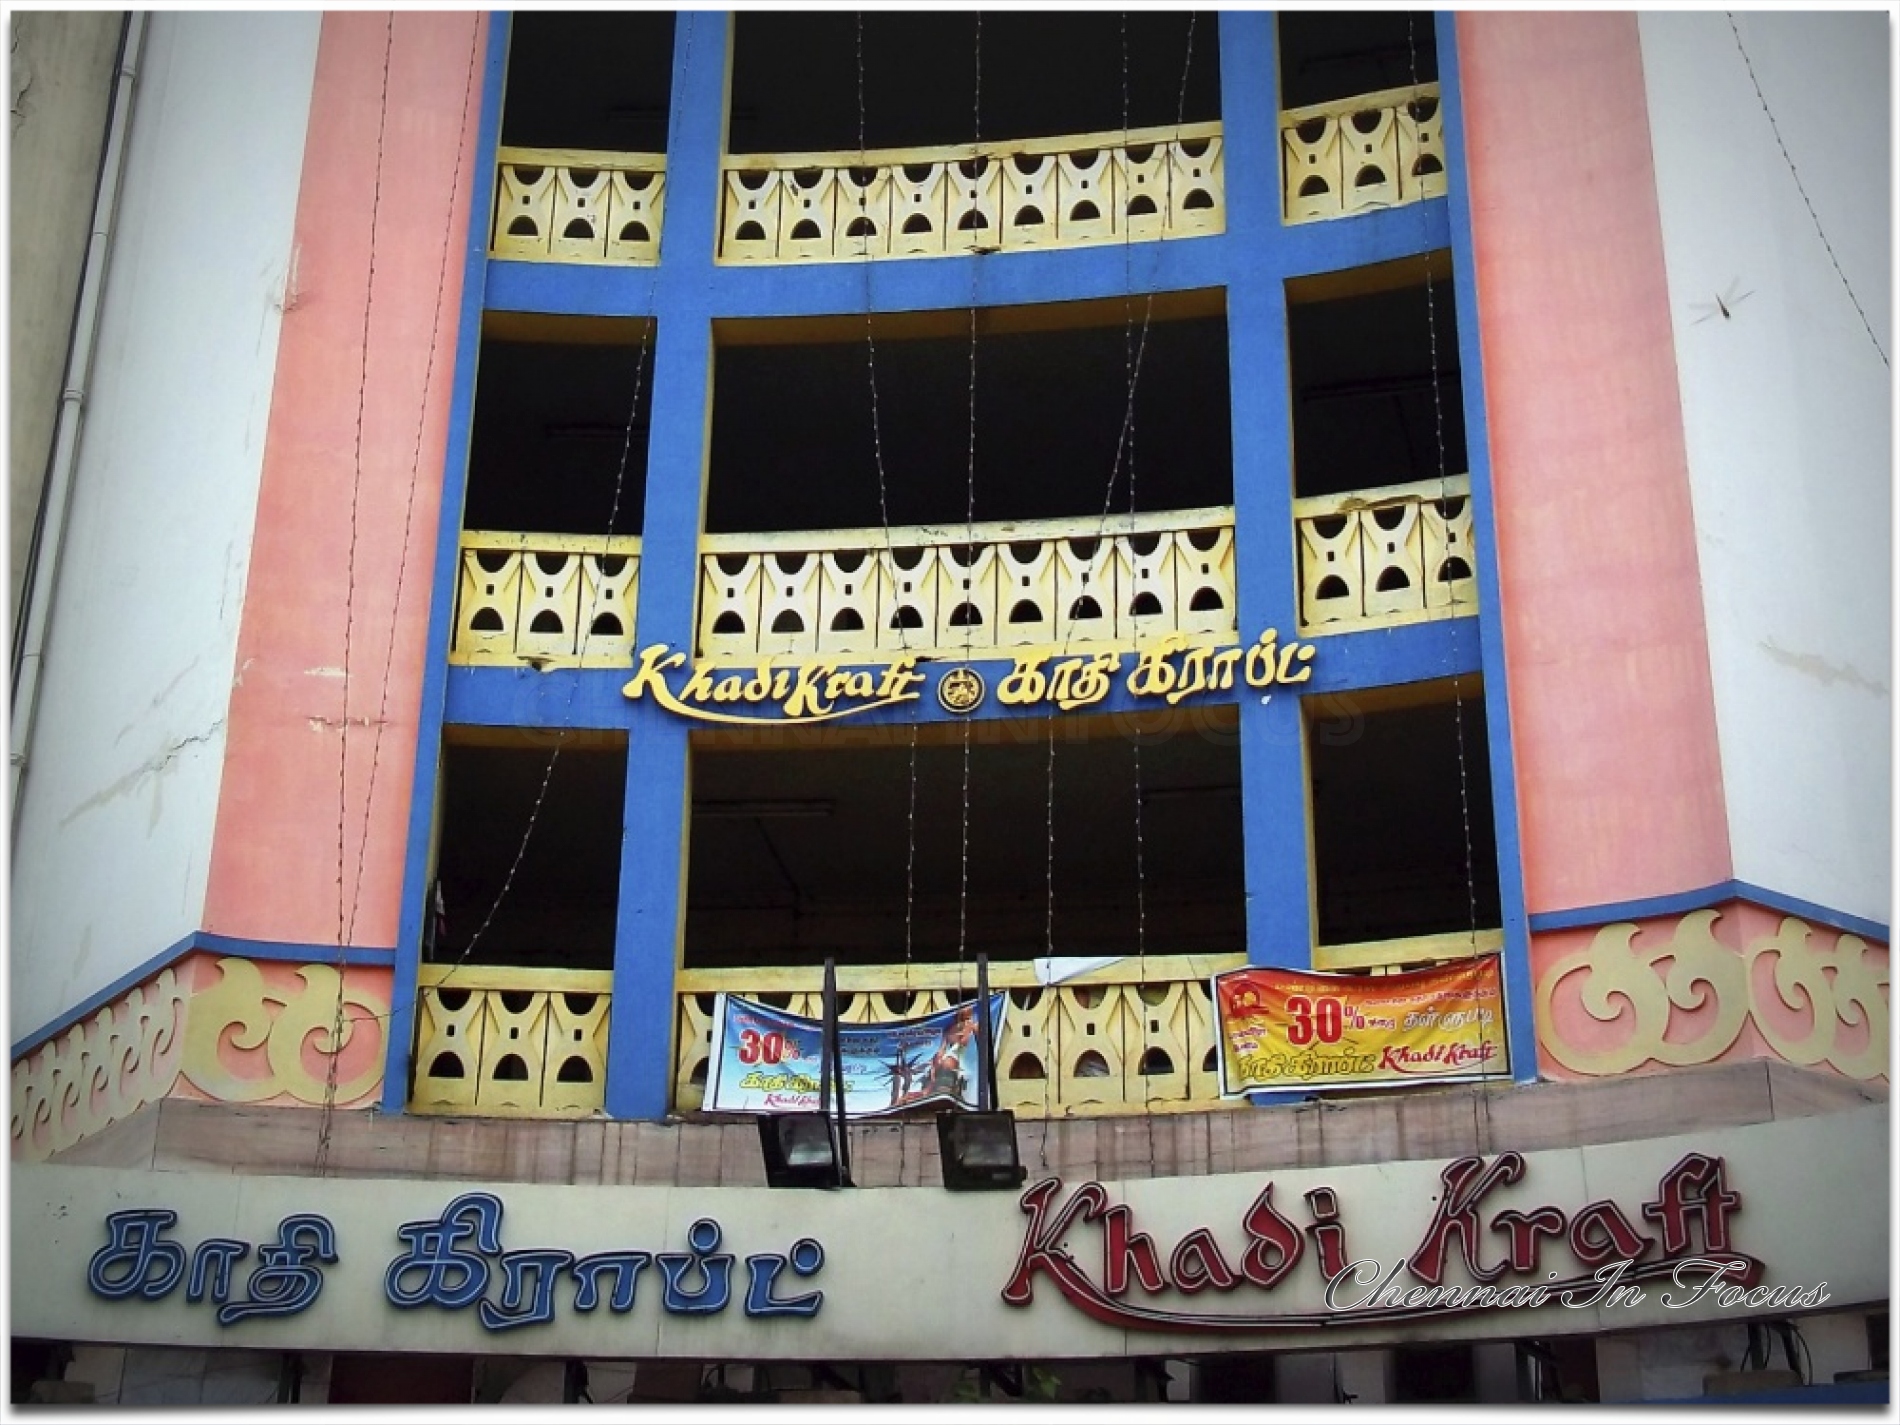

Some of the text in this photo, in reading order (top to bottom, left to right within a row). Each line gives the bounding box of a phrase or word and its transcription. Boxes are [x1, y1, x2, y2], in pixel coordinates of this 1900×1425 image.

[622, 644, 926, 723] Khadi Kraft
[996, 650, 1121, 711] காதி
[738, 1028, 801, 1065] 30%
[1284, 994, 1366, 1047] 30%
[87, 1191, 825, 1333] காதி கிராப்ட்
[1000, 1150, 1743, 1331] Khadi Kraft
